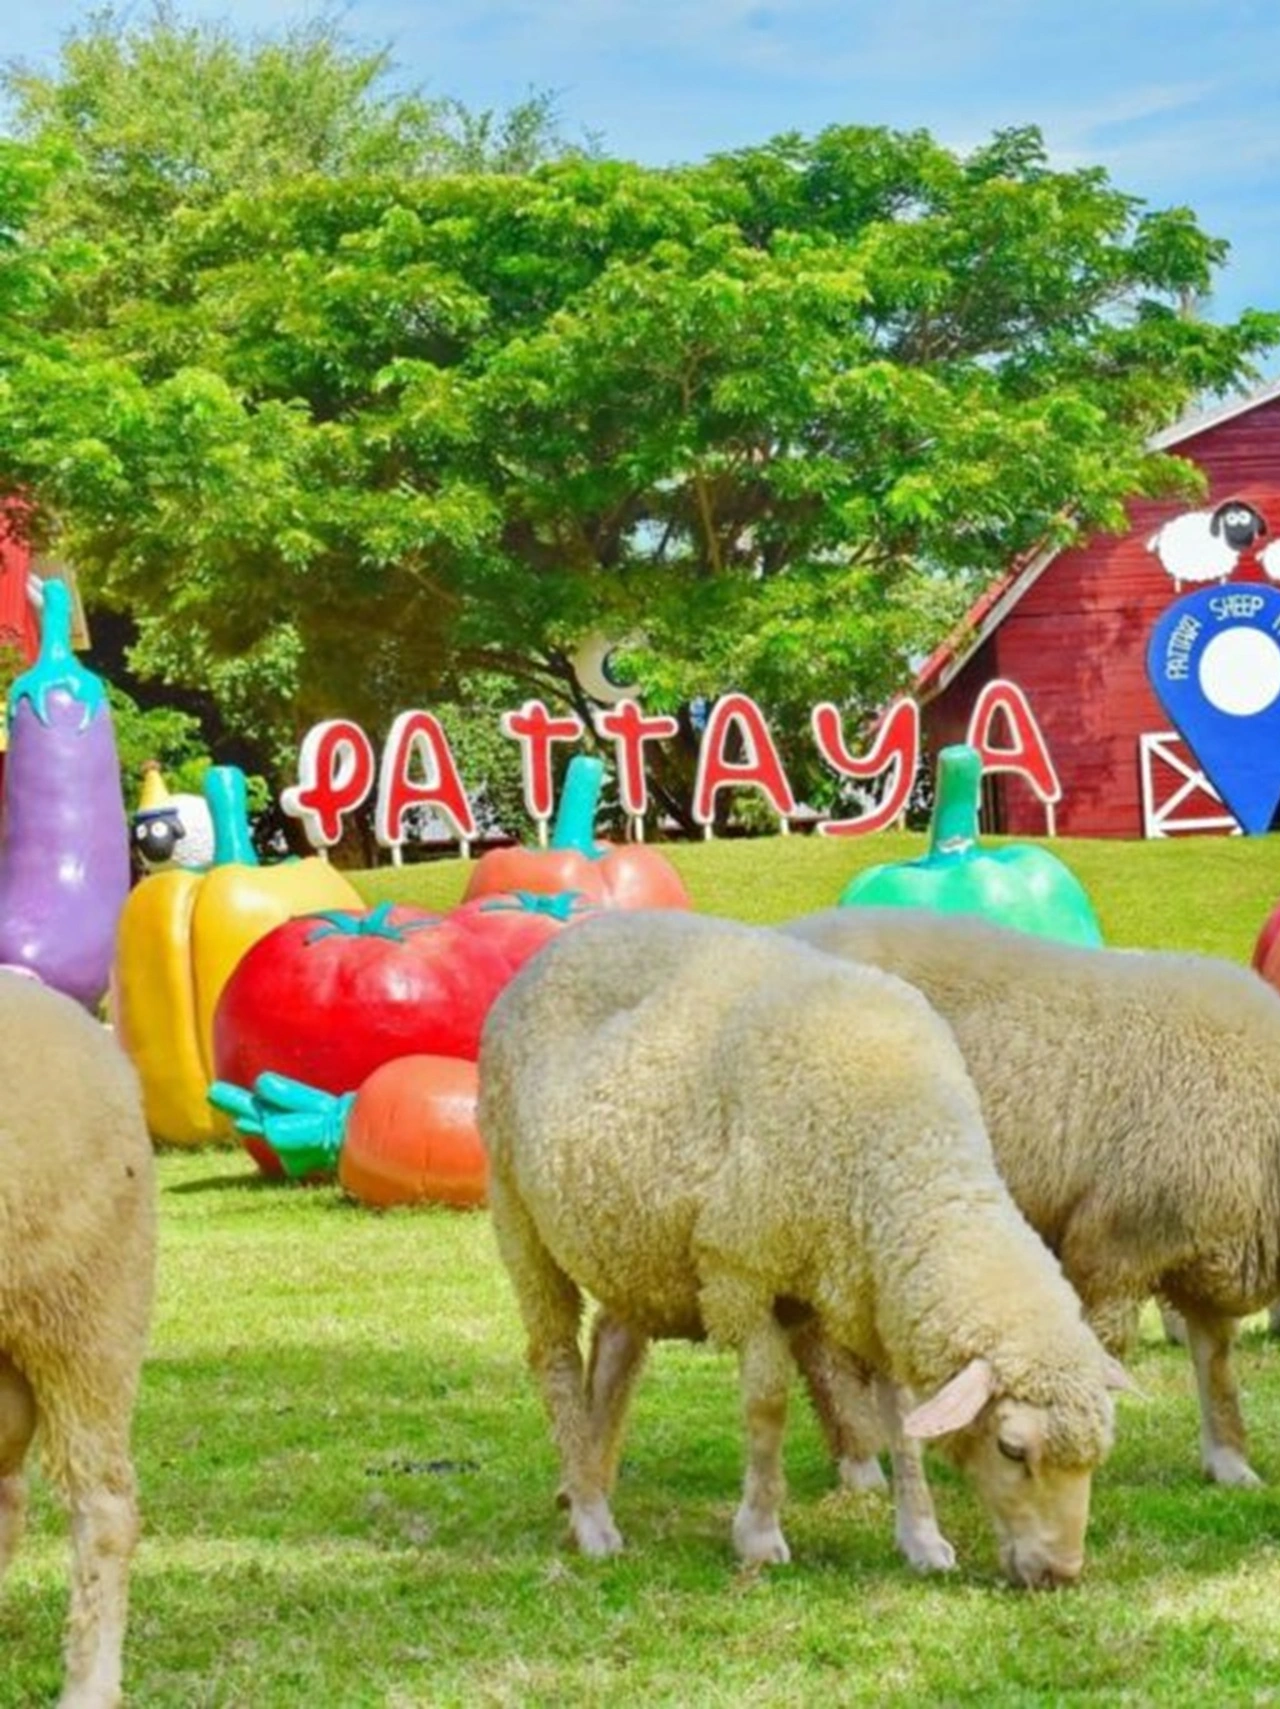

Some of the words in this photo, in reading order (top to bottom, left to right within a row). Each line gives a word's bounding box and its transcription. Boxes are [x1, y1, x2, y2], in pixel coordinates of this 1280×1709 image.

[1165, 613, 1202, 681] PATTAYA
[1208, 594, 1265, 622] SHEEP
[279, 678, 1062, 848] PATTAYA
